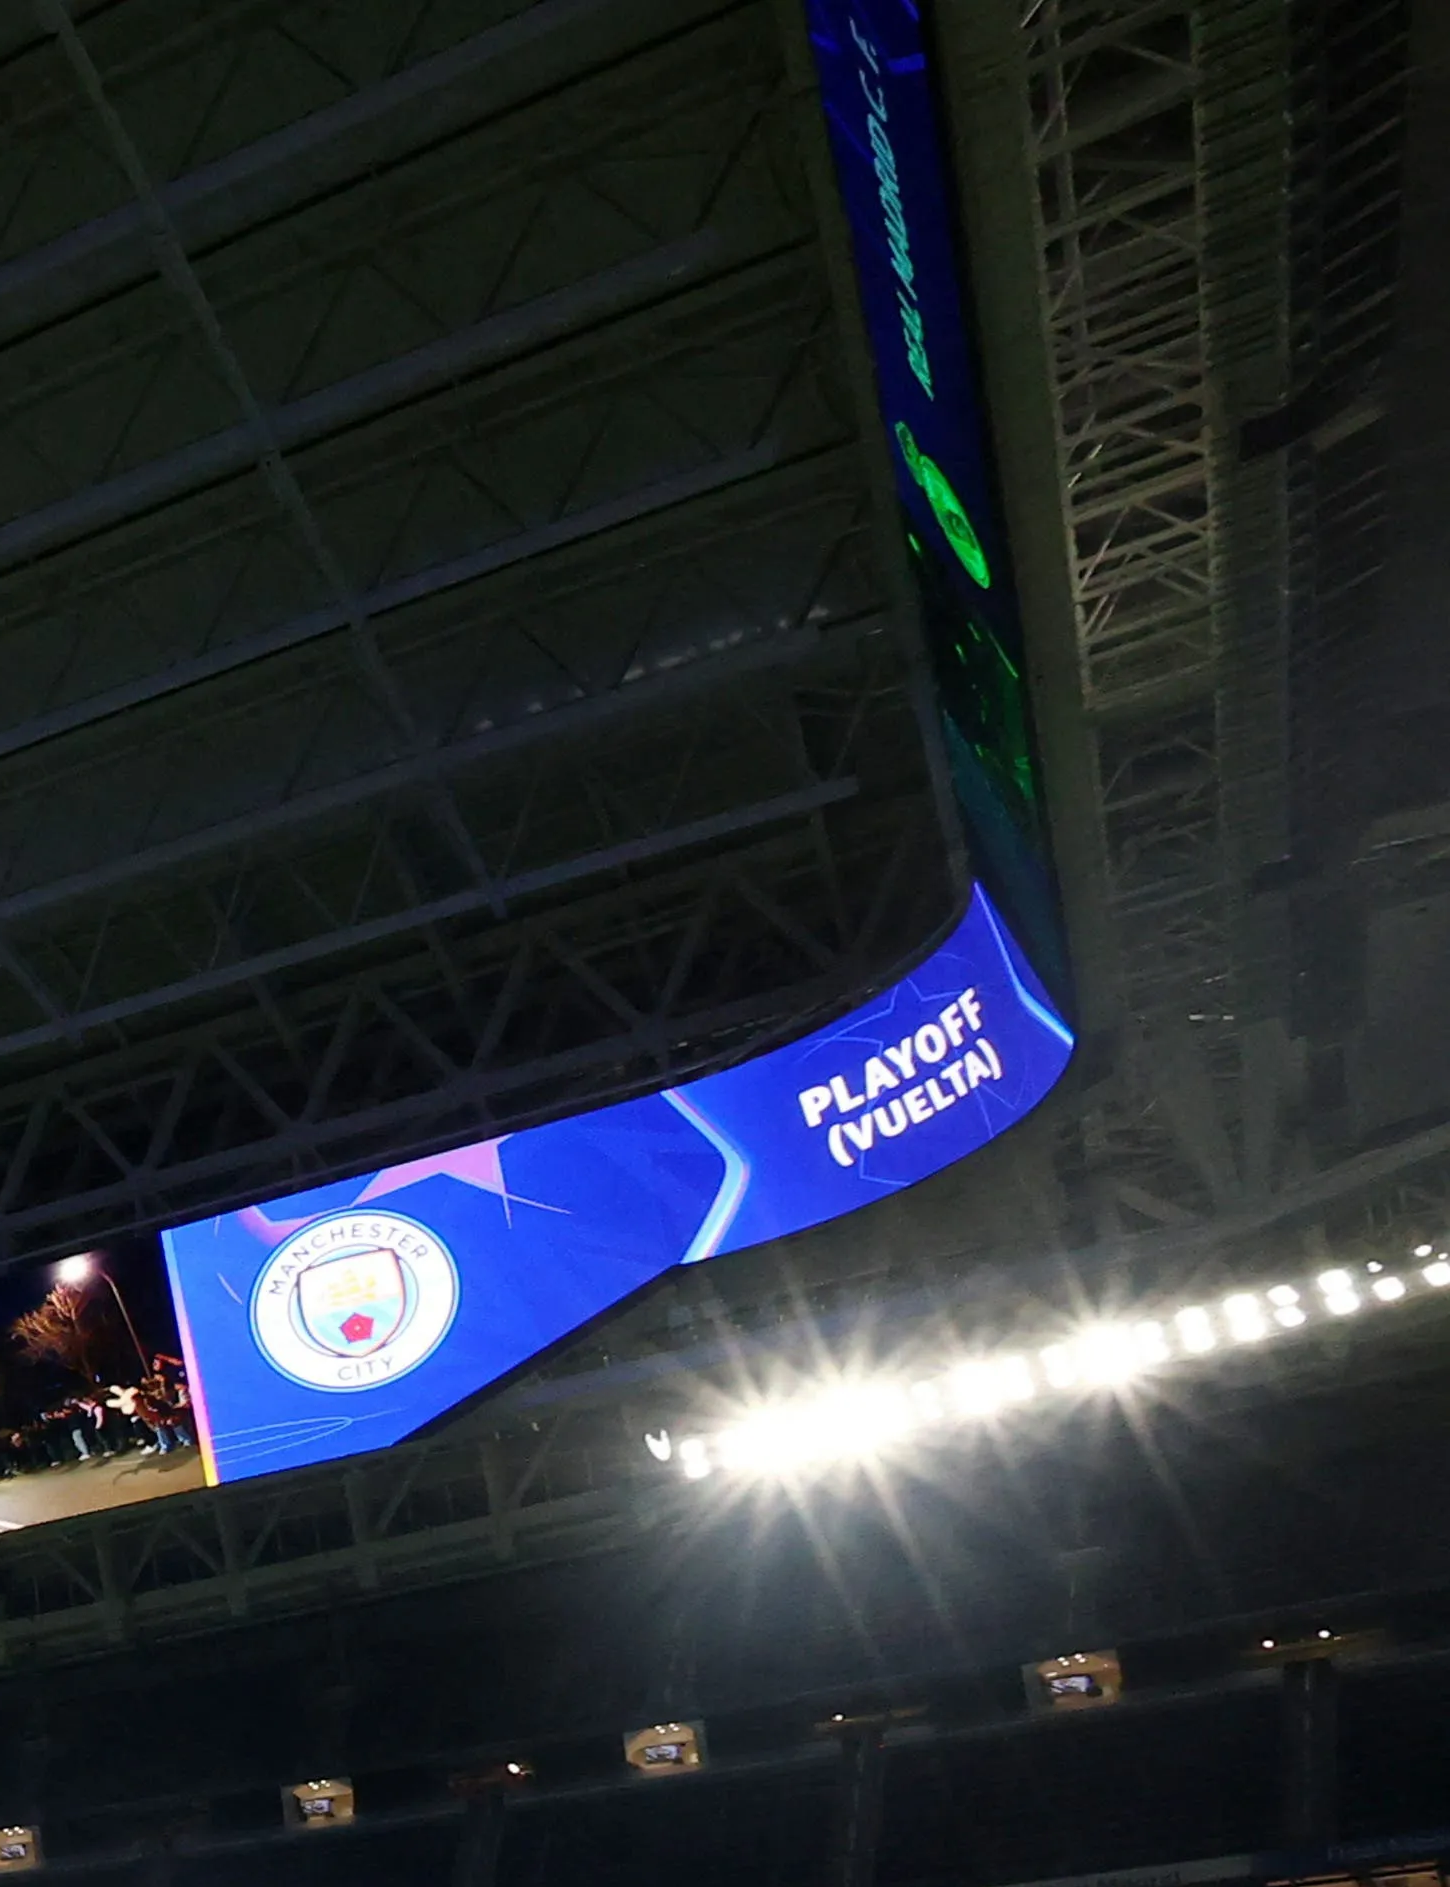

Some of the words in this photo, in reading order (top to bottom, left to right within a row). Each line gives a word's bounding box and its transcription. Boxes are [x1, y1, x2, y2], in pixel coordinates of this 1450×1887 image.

[798, 987, 982, 1128] PLAYOFF
[828, 1038, 1002, 1167] (VUELTA)
[269, 1223, 428, 1296] MANCHESTER
[337, 1357, 393, 1381] CITY
